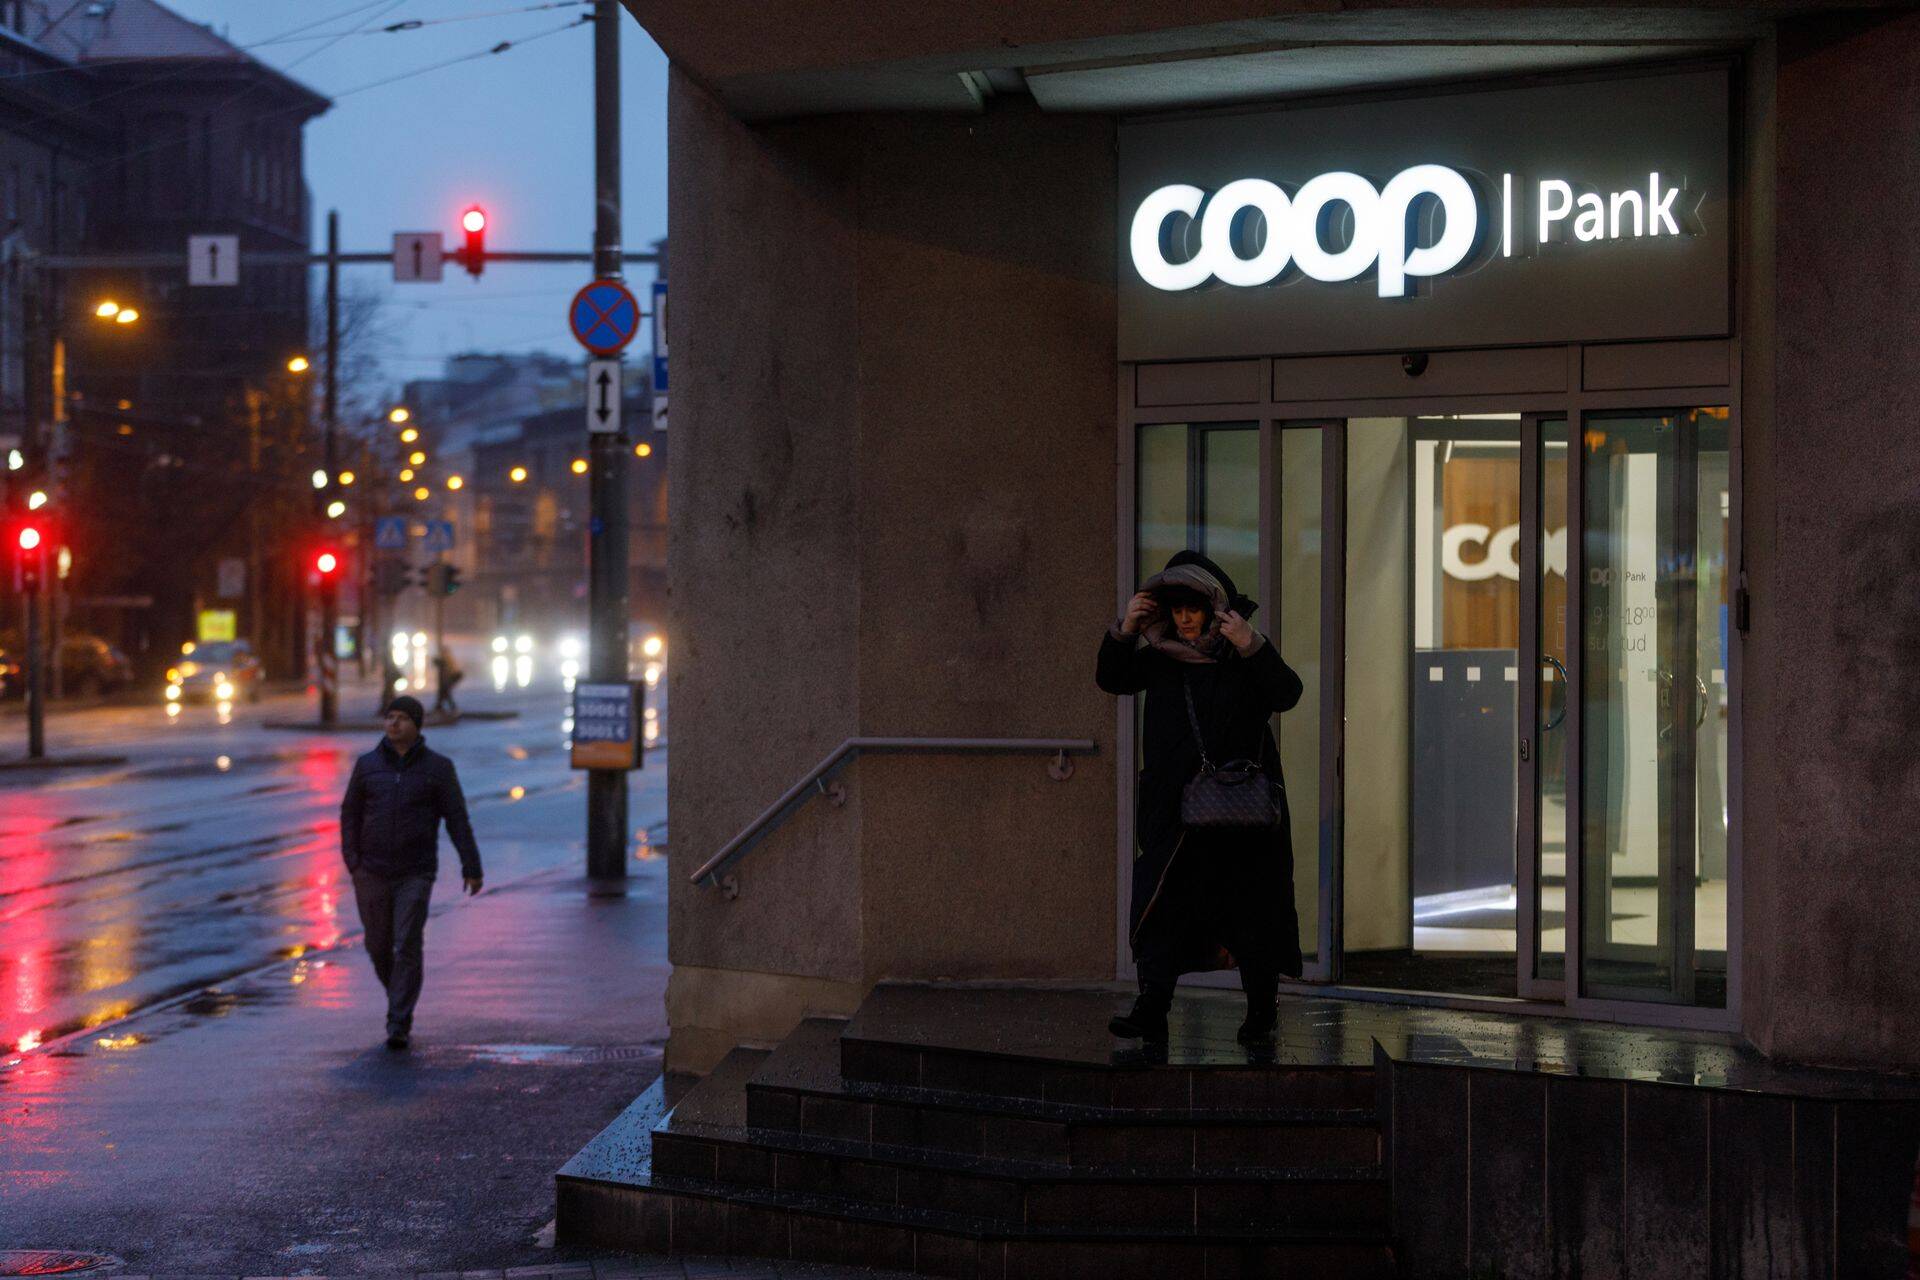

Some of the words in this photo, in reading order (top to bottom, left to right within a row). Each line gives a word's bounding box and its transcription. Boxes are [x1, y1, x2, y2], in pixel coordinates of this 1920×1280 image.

[1131, 164, 1478, 298] coop
[1539, 172, 1680, 244] Pank
[1442, 523, 1568, 581] co
[1625, 572, 1647, 582] Pank
